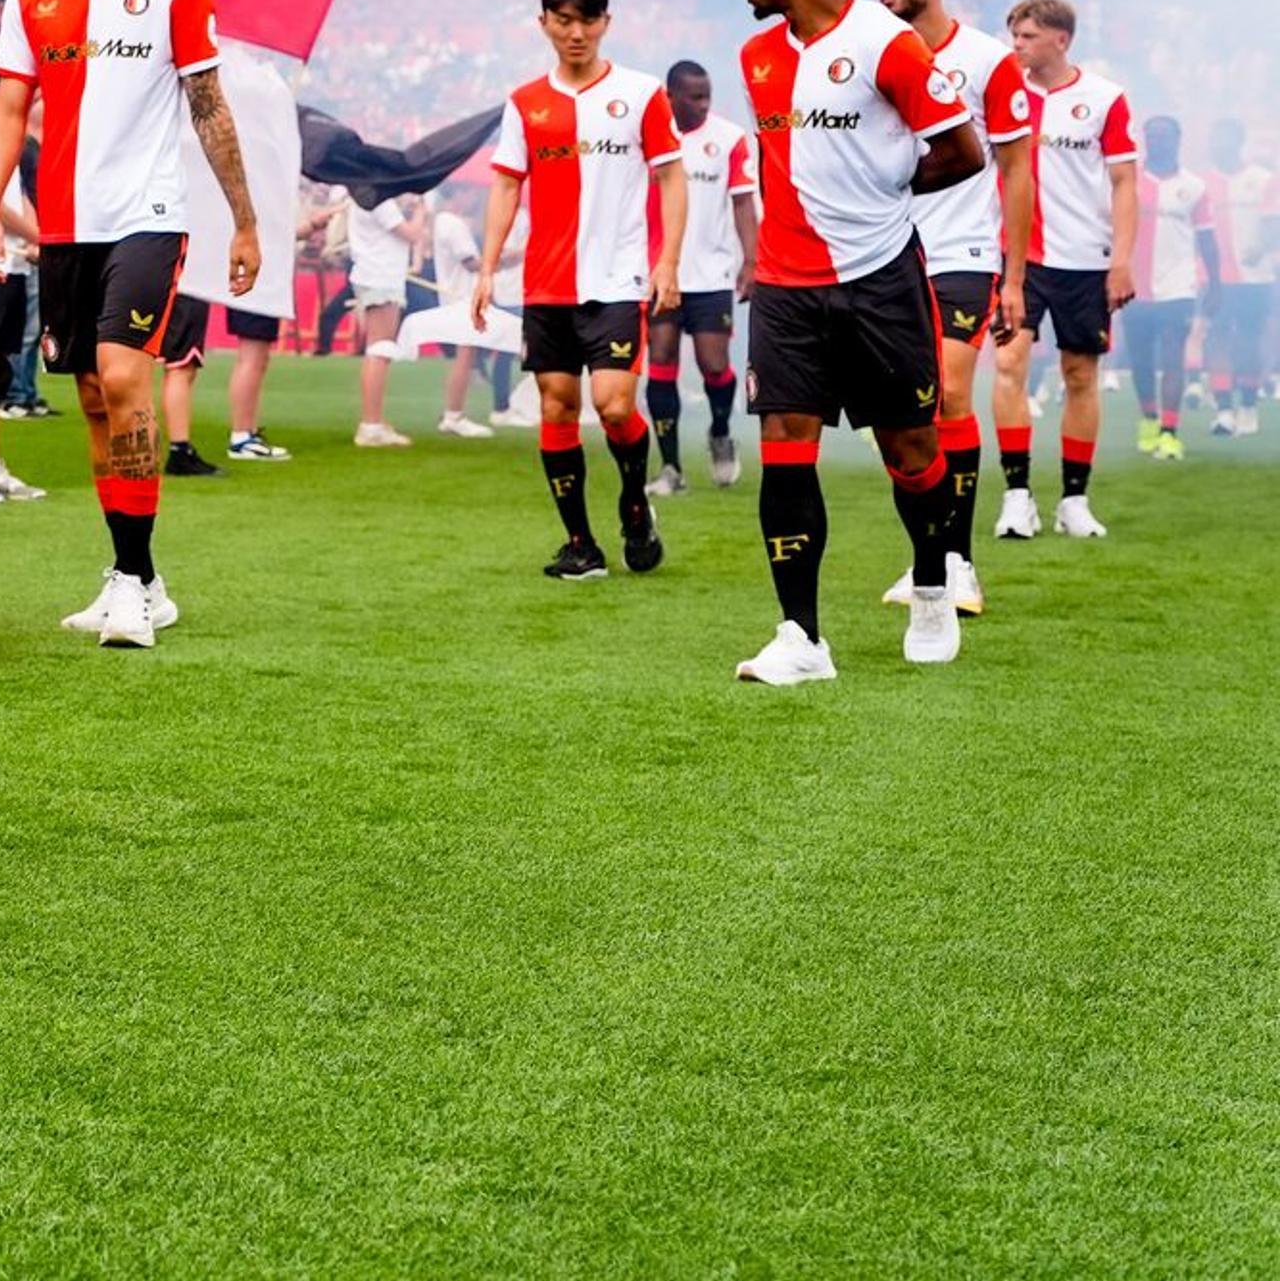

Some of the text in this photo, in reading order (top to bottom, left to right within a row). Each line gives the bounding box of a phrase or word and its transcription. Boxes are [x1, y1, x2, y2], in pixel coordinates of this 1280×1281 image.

[97, 38, 153, 59] Markt
[757, 108, 861, 132] edia Markt
[765, 534, 810, 562] F
